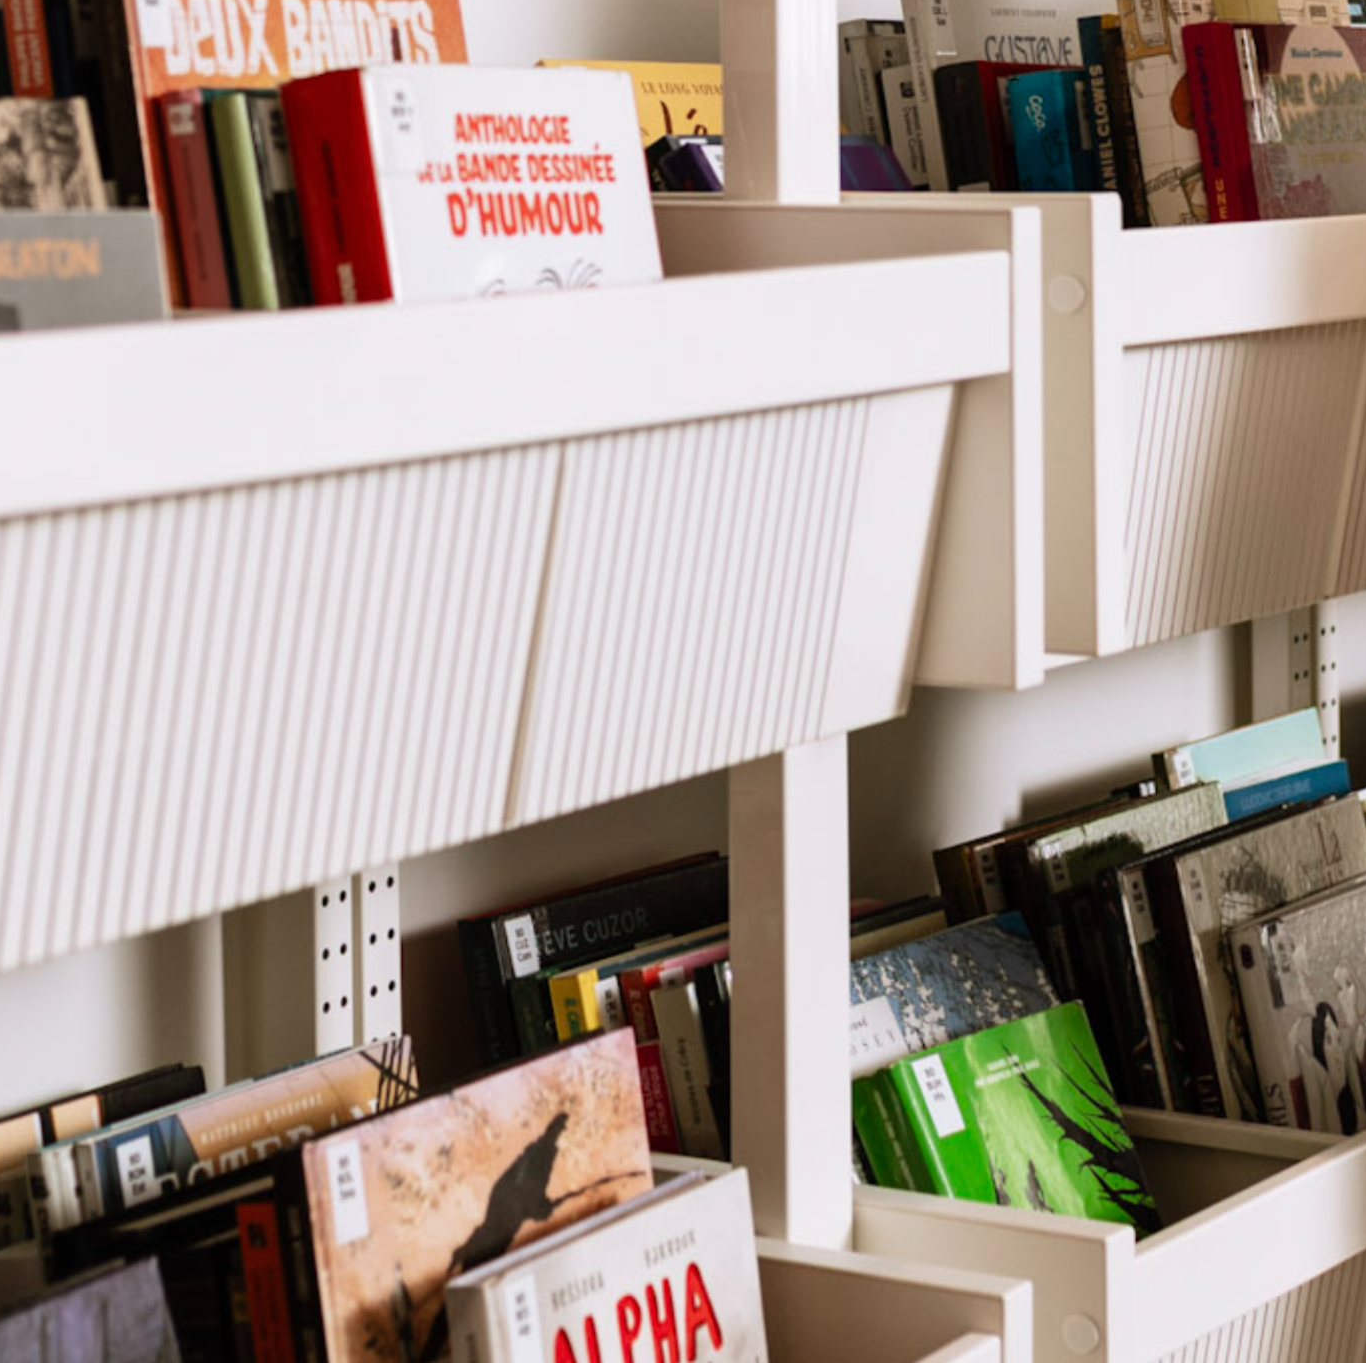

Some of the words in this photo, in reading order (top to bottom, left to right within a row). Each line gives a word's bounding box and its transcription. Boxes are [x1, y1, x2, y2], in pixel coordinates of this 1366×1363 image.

[985, 36, 1073, 65] GUSTAVE
[1089, 63, 1110, 138] CLOWES
[454, 111, 572, 144] ANTHOLOGIE
[455, 152, 523, 183] BANDE
[525, 141, 617, 183] DESSINÉE
[1097, 137, 1119, 190] ANIEL
[446, 187, 605, 237] D'HUMOUR
